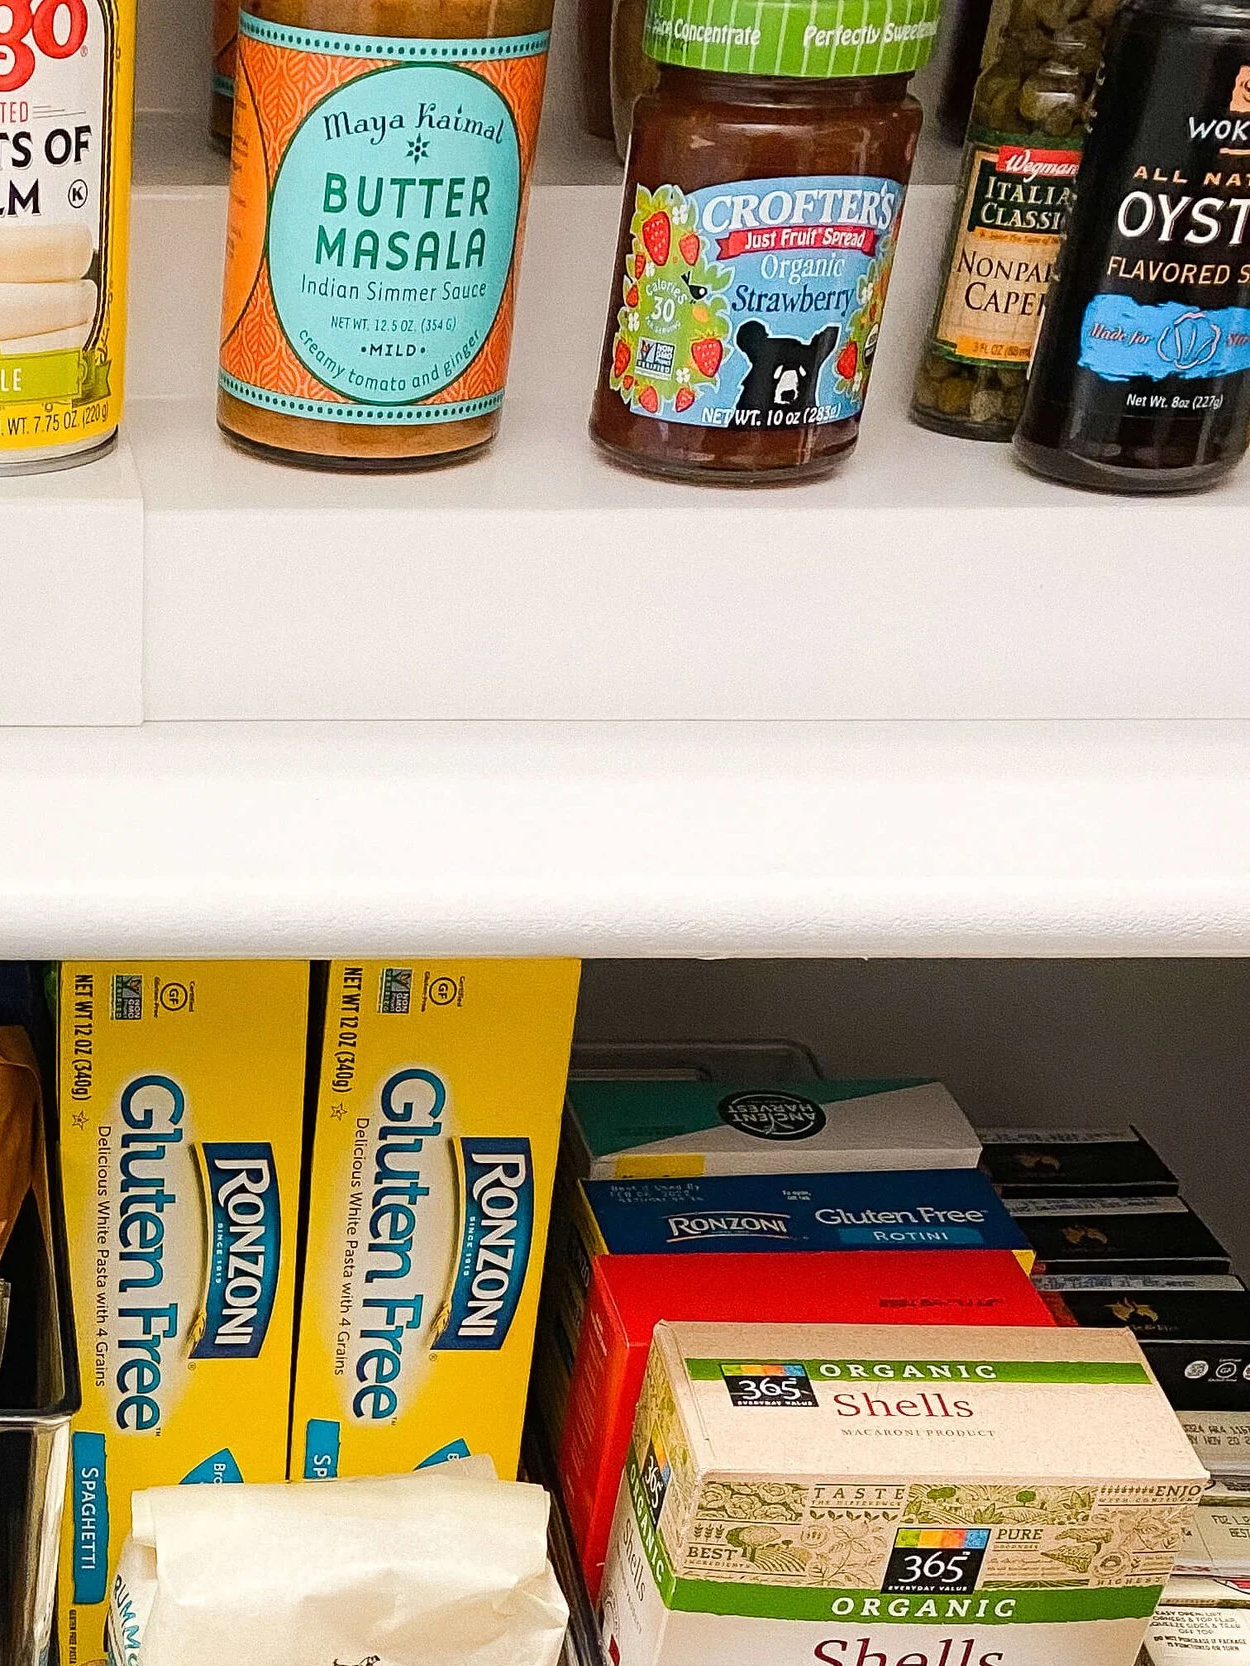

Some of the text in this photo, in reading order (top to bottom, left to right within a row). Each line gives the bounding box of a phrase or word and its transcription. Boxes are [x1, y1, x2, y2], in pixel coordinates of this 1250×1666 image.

[672, 19, 762, 47] Concentrate
[803, 23, 880, 47] Perfectly
[324, 102, 504, 145] Maya Kaimal
[44, 125, 92, 165] OF
[1133, 165, 1188, 184] ALL
[323, 172, 492, 219] BUTTER
[703, 184, 895, 232] CROFTER'S
[315, 225, 487, 271] MASALA
[744, 227, 865, 250] Just Fruit Spread
[760, 251, 846, 285] Organic
[1106, 256, 1230, 285] FLAVORED
[301, 274, 488, 302] Indian Simmer Sauce
[731, 284, 855, 317] Strawberry
[299, 329, 483, 392] creamy tomato and ginger
[1126, 393, 1223, 411] Net Wt. 8oz (227g)
[7, 415, 29, 436] WT.
[32, 412, 60, 434] 7.75
[81, 404, 102, 429] (220
[668, 1215, 788, 1237] RONZONI
[815, 1207, 984, 1225] Gluten Free
[355, 1068, 447, 1421] Gluten Free
[457, 1153, 527, 1338] RONZONI
[874, 1230, 950, 1242] ROTINI
[94, 1125, 112, 1388] Delicious White Pasta with 4 Grains
[116, 1074, 186, 1432] Gluten Free
[214, 1156, 271, 1346] RONZONI
[819, 1362, 998, 1380] ORGANIC
[738, 1376, 800, 1401] 365
[834, 1392, 975, 1420] Shells
[840, 1427, 998, 1438] MACARONI PRODUCT
[80, 1466, 100, 1571] SPAGHETTI
[996, 1528, 1044, 1543] PURE
[898, 1550, 964, 1585] 365
[888, 1584, 969, 1593] EVERYDAY VALUE
[831, 1595, 1017, 1620] ORGANIC
